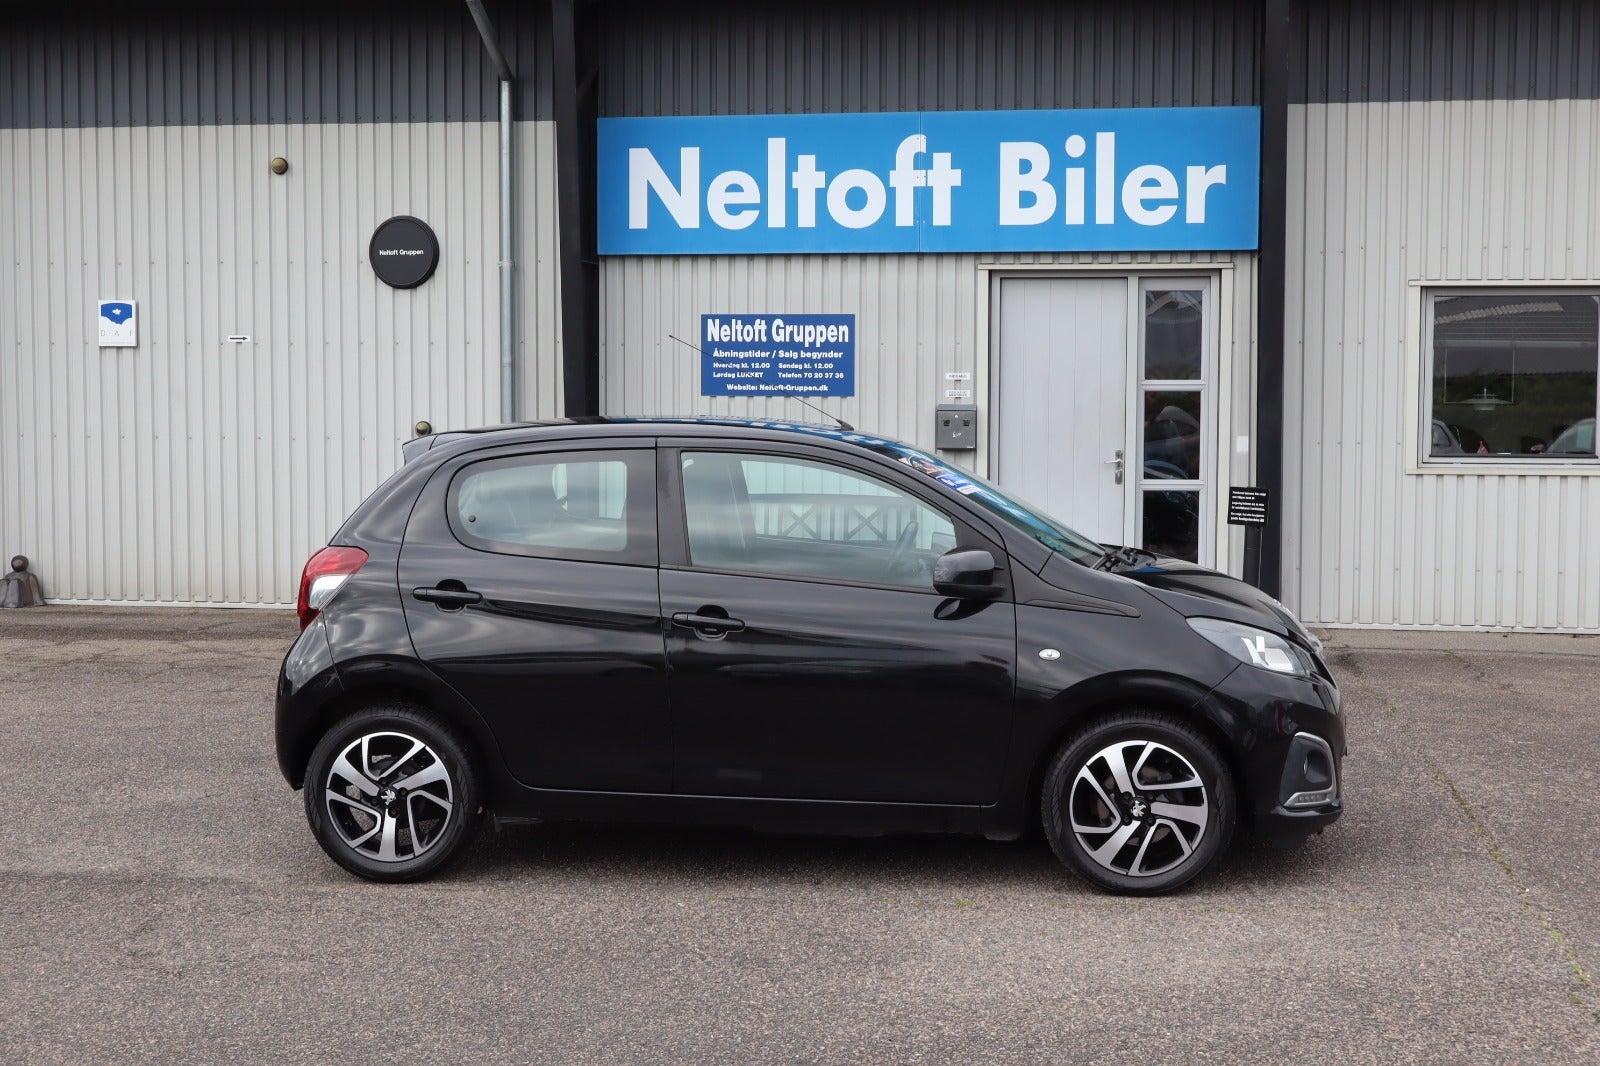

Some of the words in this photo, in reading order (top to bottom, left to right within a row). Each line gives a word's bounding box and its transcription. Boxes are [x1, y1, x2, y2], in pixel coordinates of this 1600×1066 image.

[628, 134, 962, 231] Neltoft
[999, 131, 1227, 227] Biler
[707, 318, 767, 342] Neltoft
[771, 318, 849, 347] Gruppen
[713, 348, 771, 359] Åbningstider
[778, 350, 799, 359] Salg
[800, 350, 844, 359] begynder
[713, 362, 740, 370] Hverdag
[778, 362, 803, 370] Søndag
[726, 383, 758, 391] Website:
